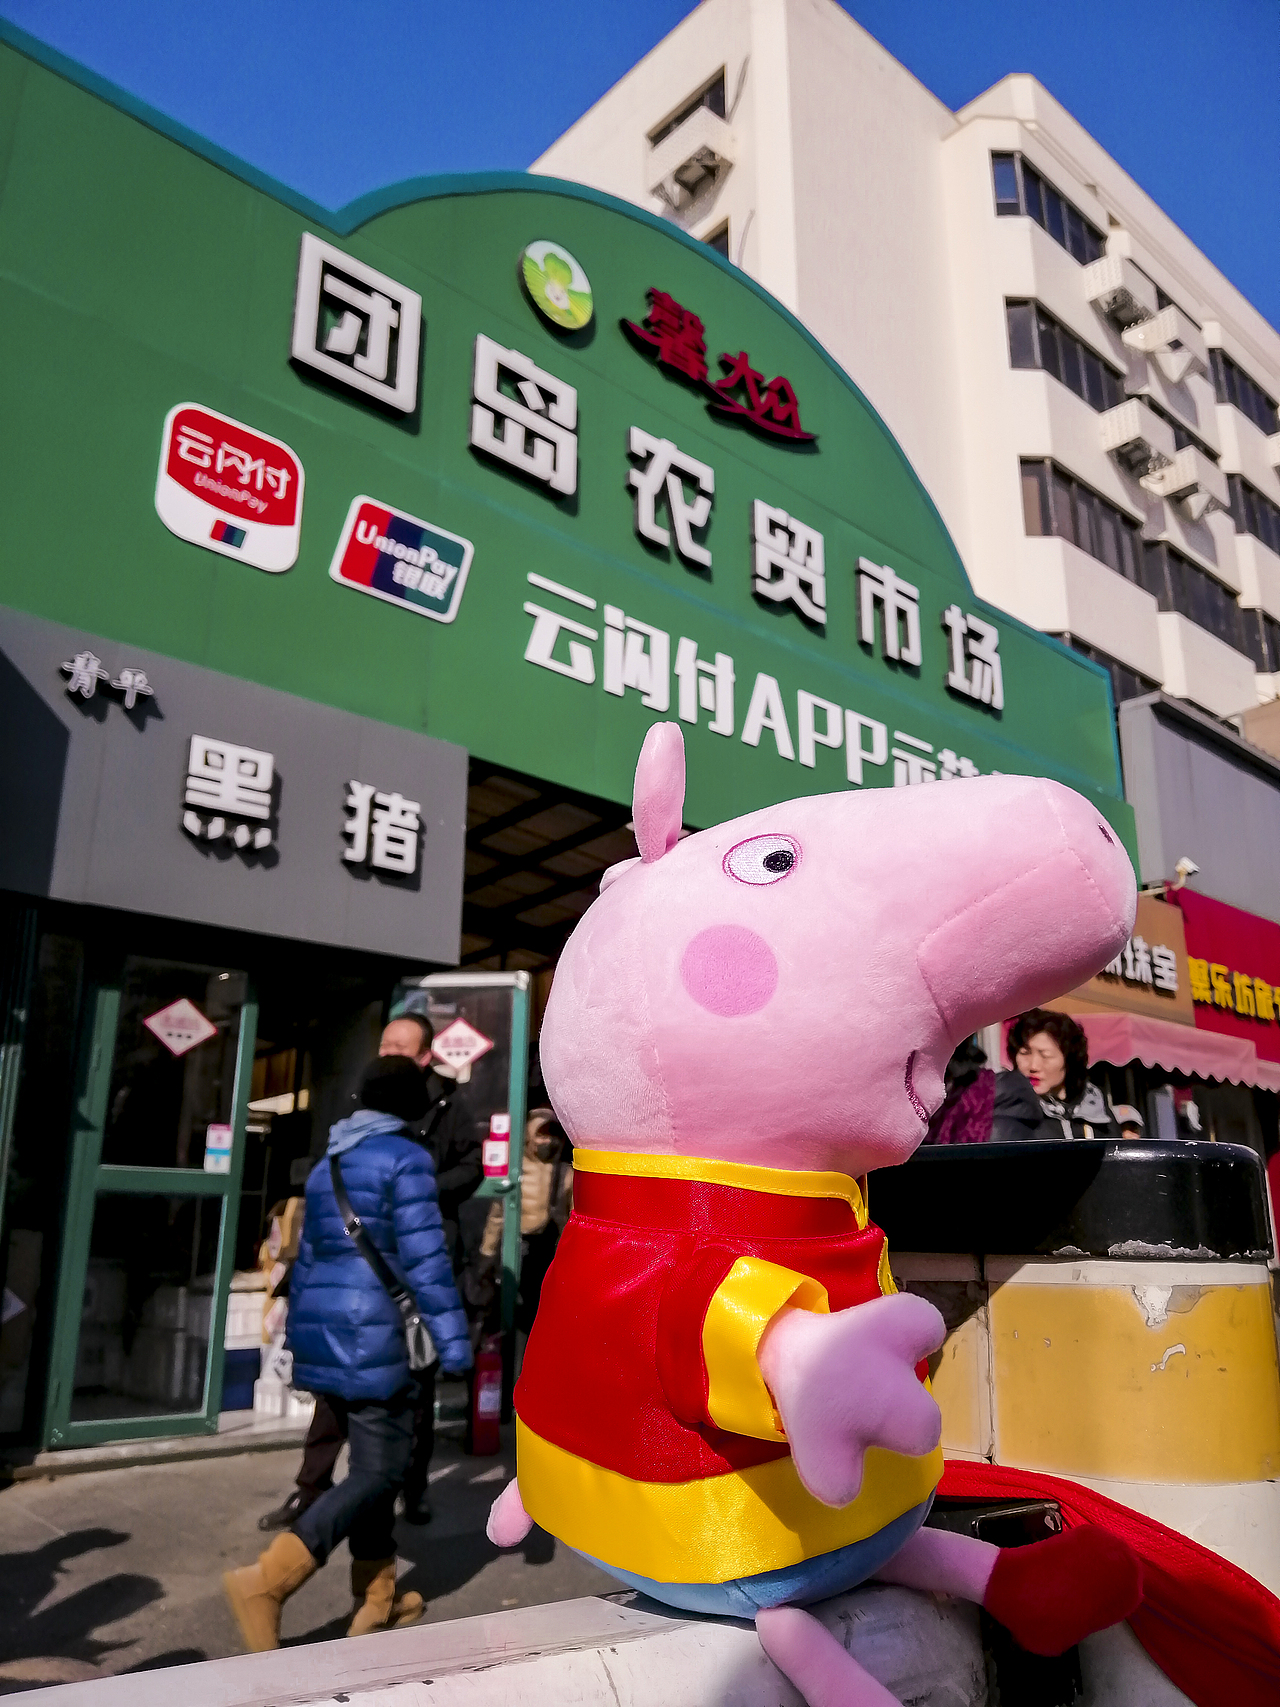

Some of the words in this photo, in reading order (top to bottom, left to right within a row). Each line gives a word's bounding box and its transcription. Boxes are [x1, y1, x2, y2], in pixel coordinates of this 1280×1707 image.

[627, 287, 814, 439] 馨大众
[176, 425, 291, 499] 云闪付
[193, 471, 268, 514] UnionPay
[291, 232, 1004, 711] 团岛农贸市场
[356, 519, 458, 586] UnionPay
[392, 560, 446, 600] 银联
[522, 571, 1003, 789] 云闪付APP示
[182, 733, 422, 875] 黑猪
[1104, 935, 1179, 991] 珠宝
